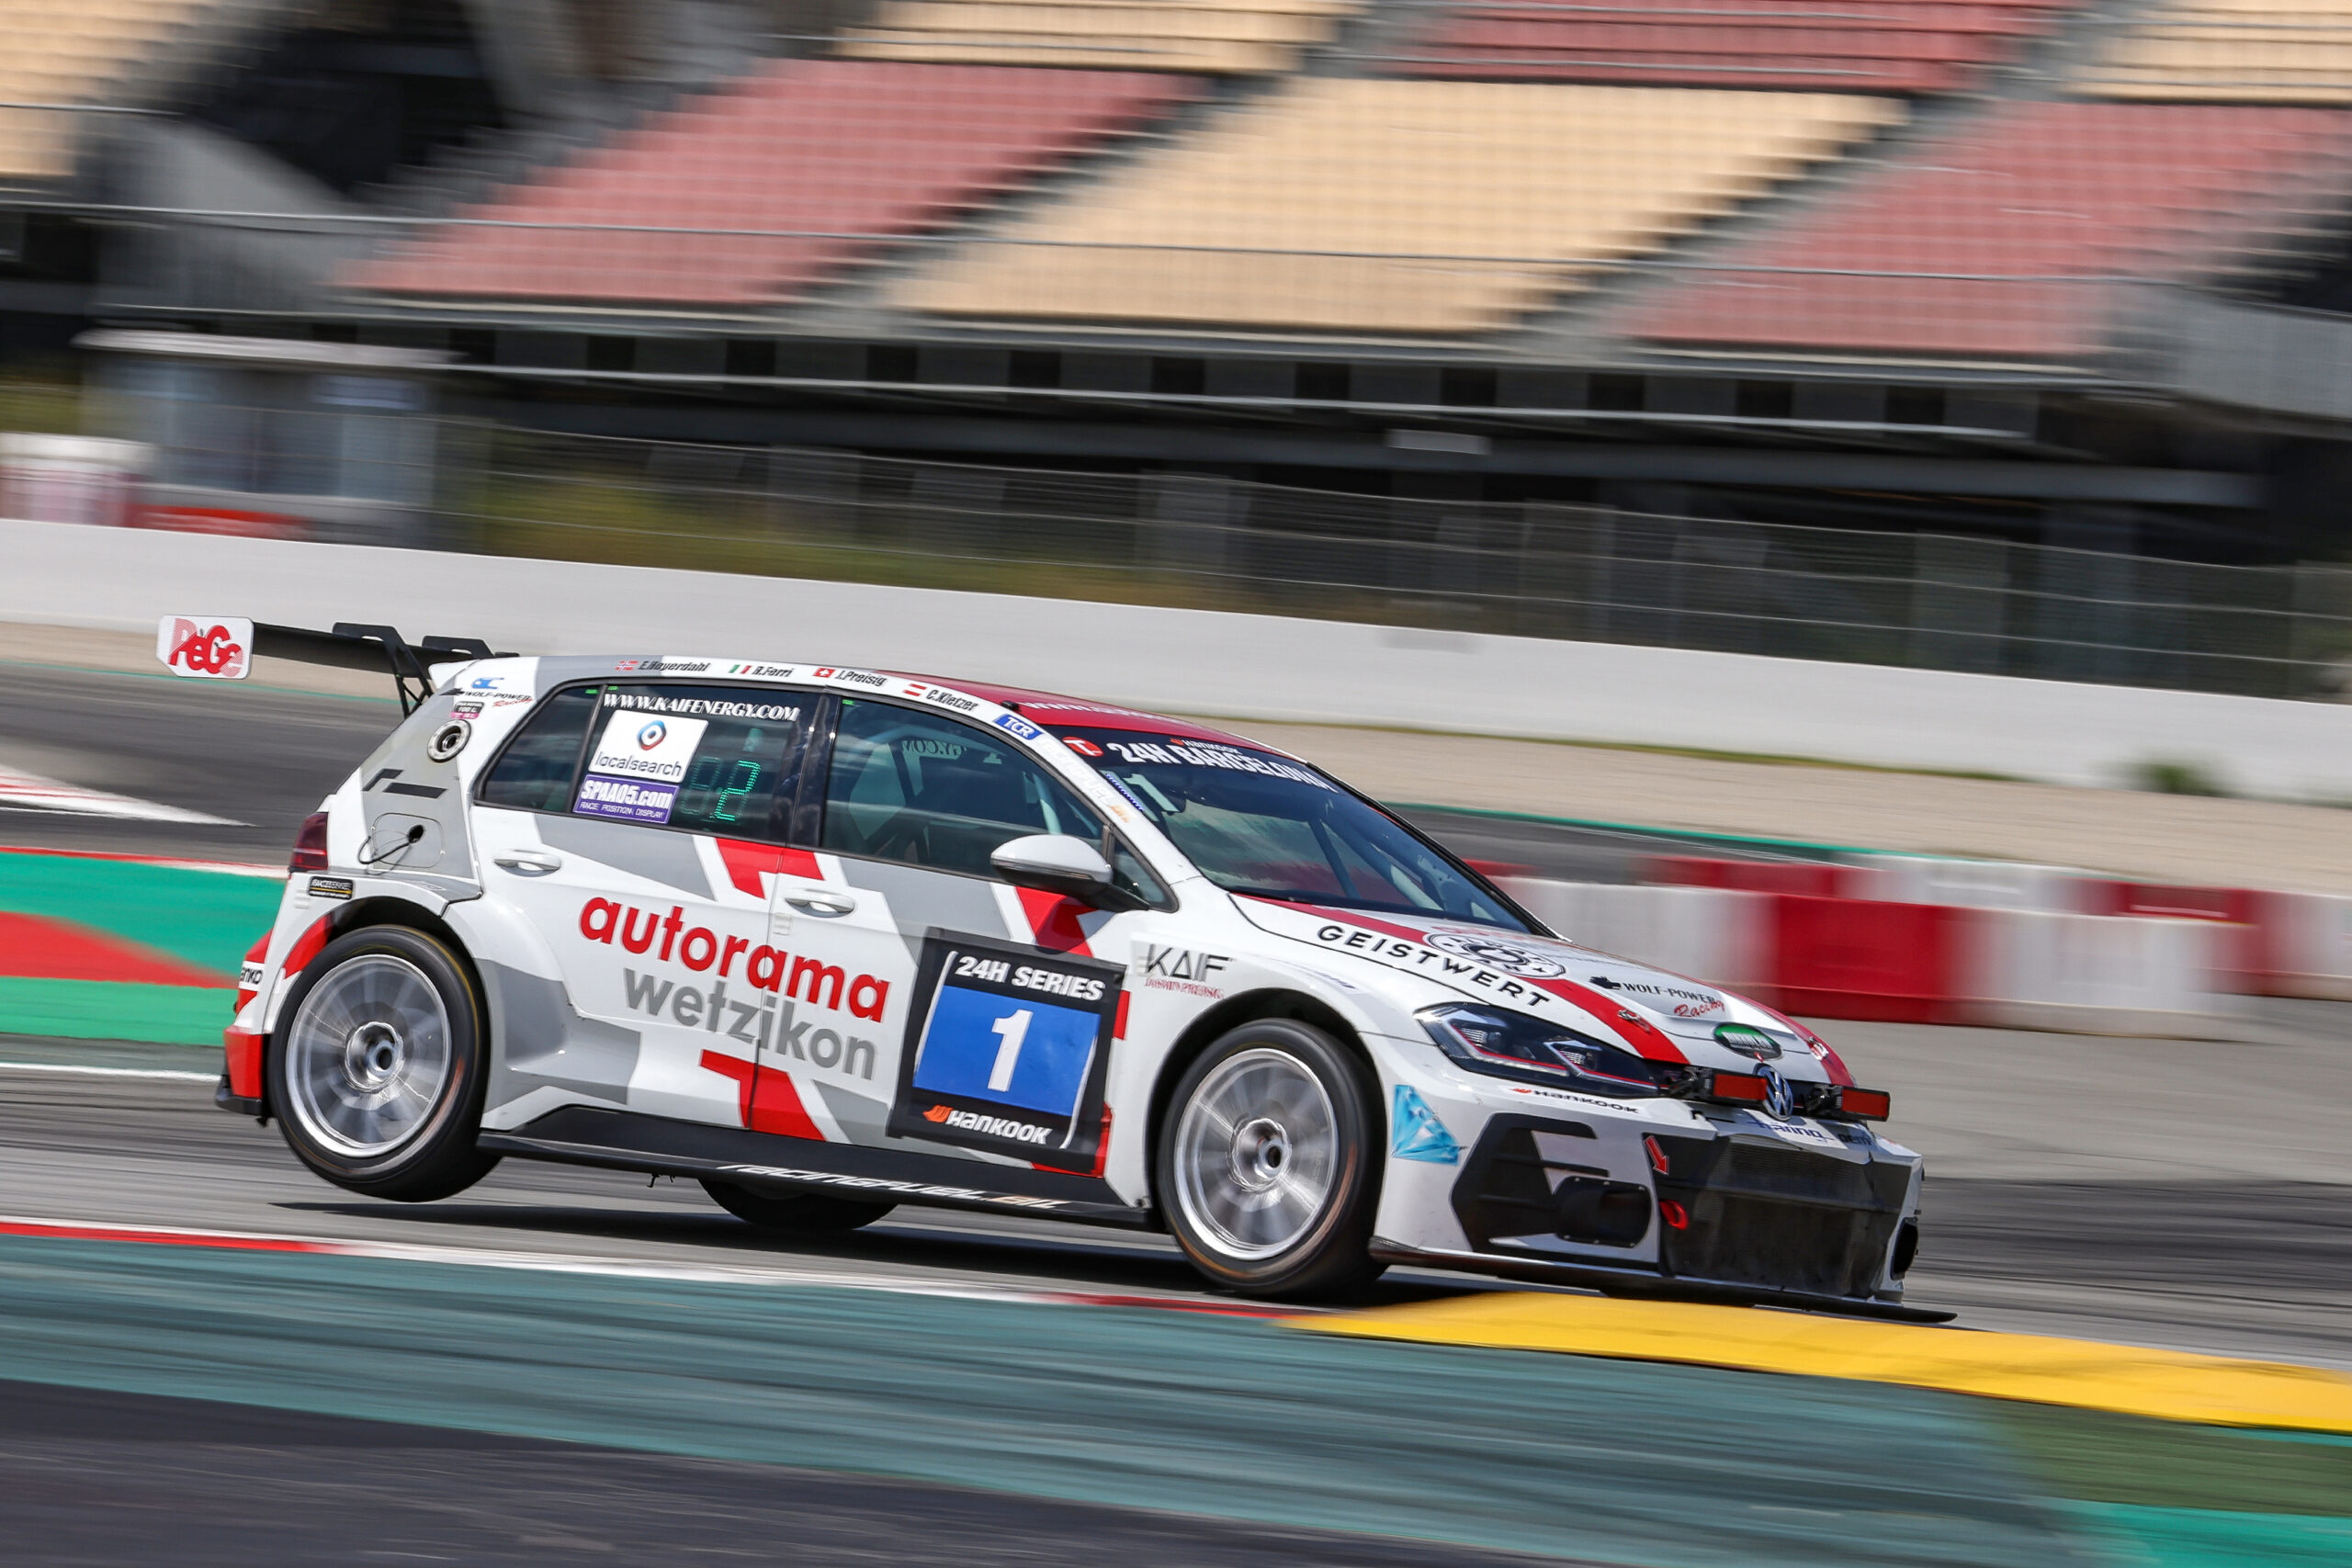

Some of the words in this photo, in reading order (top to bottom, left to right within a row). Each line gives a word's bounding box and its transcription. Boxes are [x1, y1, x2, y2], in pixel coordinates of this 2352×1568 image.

[604, 694, 800, 722] WWW.KAIFENERGY.COM
[925, 689, 979, 712] C.Kletzer
[1004, 716, 1035, 739] TCR
[594, 751, 684, 777] localsearch
[1106, 742, 1182, 764] 24H
[1165, 744, 1339, 794] BARCELONA
[581, 780, 673, 809] SPAA05.com
[580, 801, 601, 811] RACE
[602, 804, 632, 815] POSITION
[635, 808, 664, 818] DISPLAY
[579, 897, 891, 1022] autorama
[1317, 925, 1551, 1007] GEISTWERT
[955, 955, 1011, 983] 24H
[1012, 966, 1106, 1001] SERIES
[1622, 982, 1715, 1003] WOLF-POWER
[624, 967, 878, 1080] wetzikon
[987, 1009, 1035, 1092] 1
